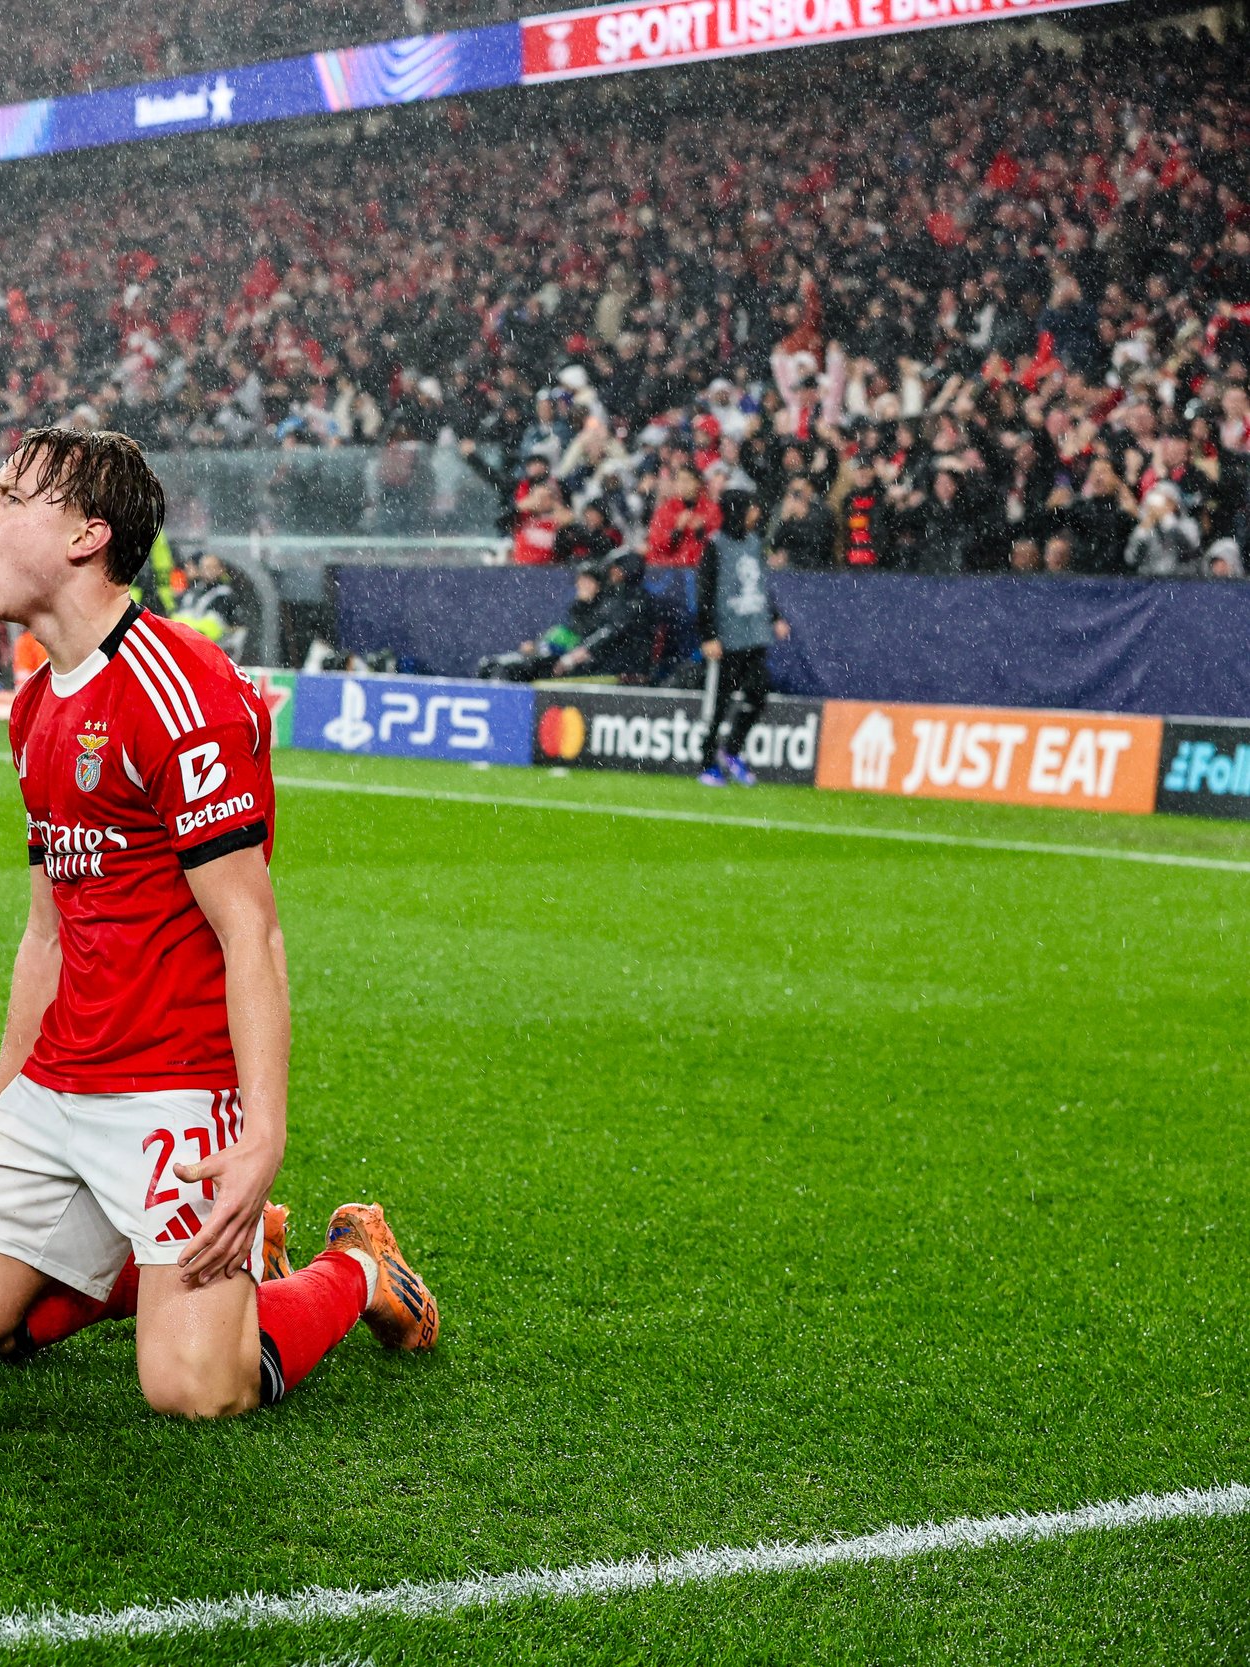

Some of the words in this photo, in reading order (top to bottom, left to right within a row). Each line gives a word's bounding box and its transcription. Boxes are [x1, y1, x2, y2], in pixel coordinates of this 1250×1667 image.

[596, 0, 712, 63] SPORT
[717, 0, 852, 46] LISBOA
[379, 692, 491, 749] PS5
[590, 709, 818, 770] masteard
[901, 719, 1028, 795] JUST
[1027, 725, 1131, 798] EAT
[175, 792, 254, 836] Betano
[142, 1127, 215, 1212] 21
